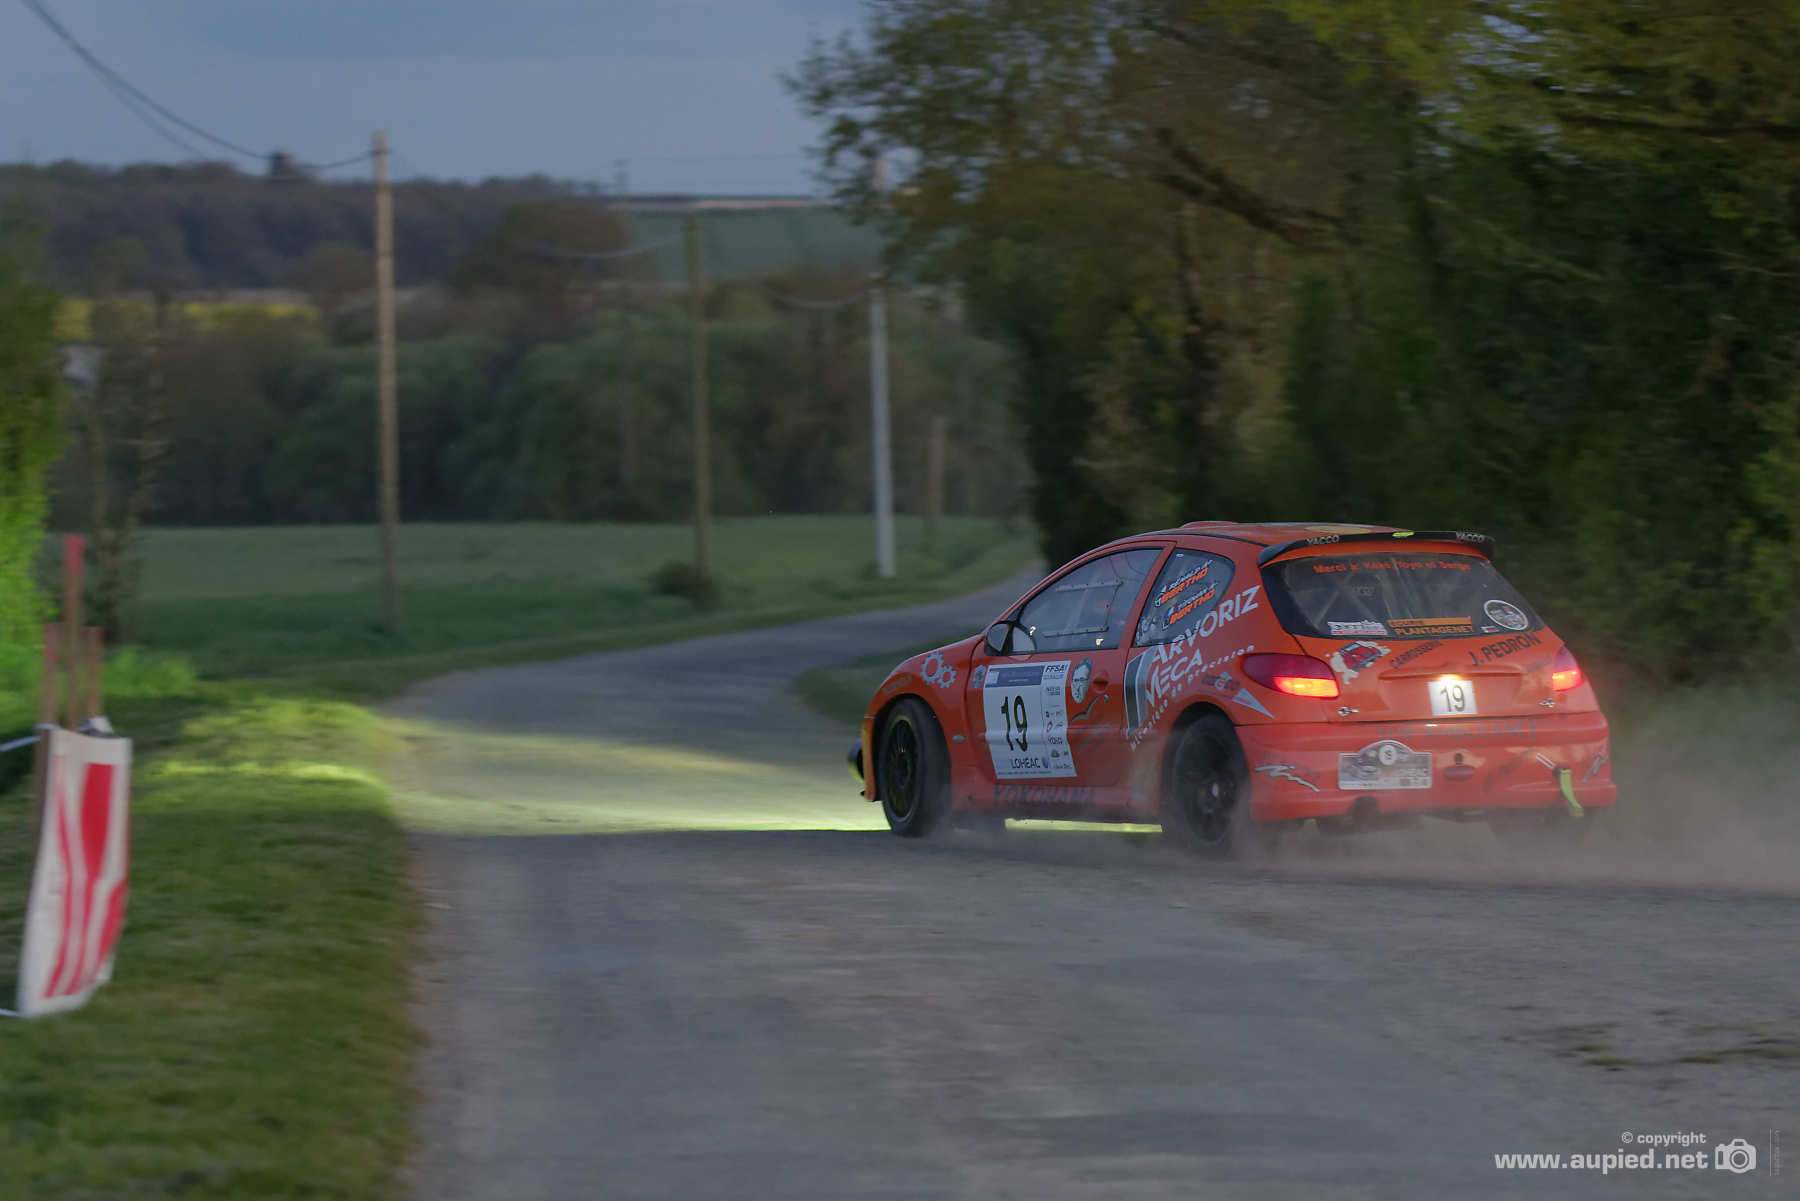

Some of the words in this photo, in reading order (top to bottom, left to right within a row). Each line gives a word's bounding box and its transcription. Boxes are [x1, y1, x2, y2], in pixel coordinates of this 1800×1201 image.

[1307, 535, 1340, 545] YACCO
[1456, 531, 1485, 543] YACCO
[1161, 567, 1208, 603] BERTHO
[1169, 588, 1216, 624] BERTHO
[1394, 624, 1474, 636] PLANTAGENET
[1440, 684, 1466, 713] 19
[1001, 695, 1028, 752] 19
[1011, 757, 1041, 769] LOHEAC
